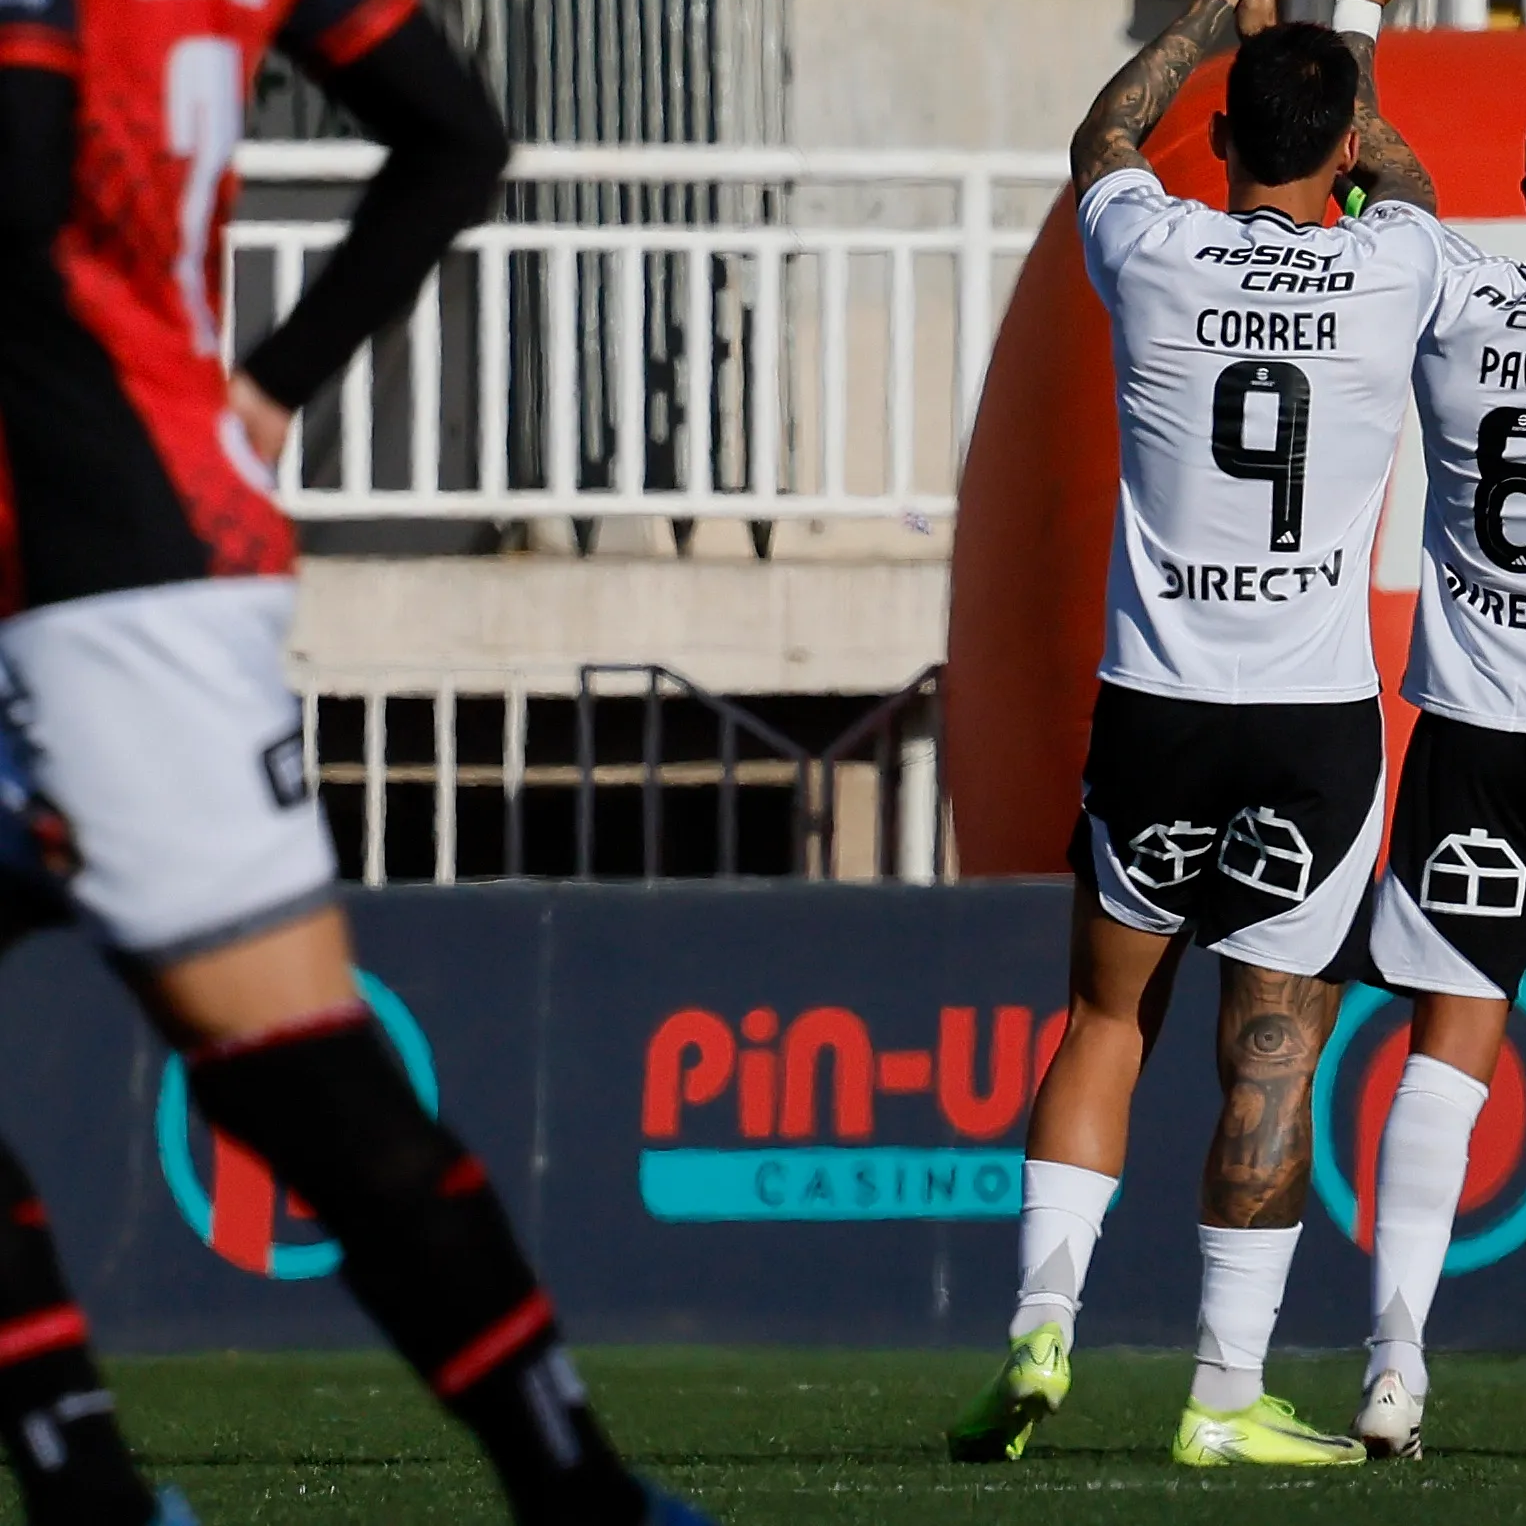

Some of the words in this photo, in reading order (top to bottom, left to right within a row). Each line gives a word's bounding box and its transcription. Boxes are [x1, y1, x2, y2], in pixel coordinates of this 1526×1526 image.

[1194, 243, 1343, 273] ASSIST
[1240, 270, 1356, 294] CARD
[1196, 307, 1339, 351] CORREA
[1211, 359, 1314, 554] 9
[1157, 547, 1345, 602] DIRECTV
[754, 1158, 1014, 1208] CASINO
